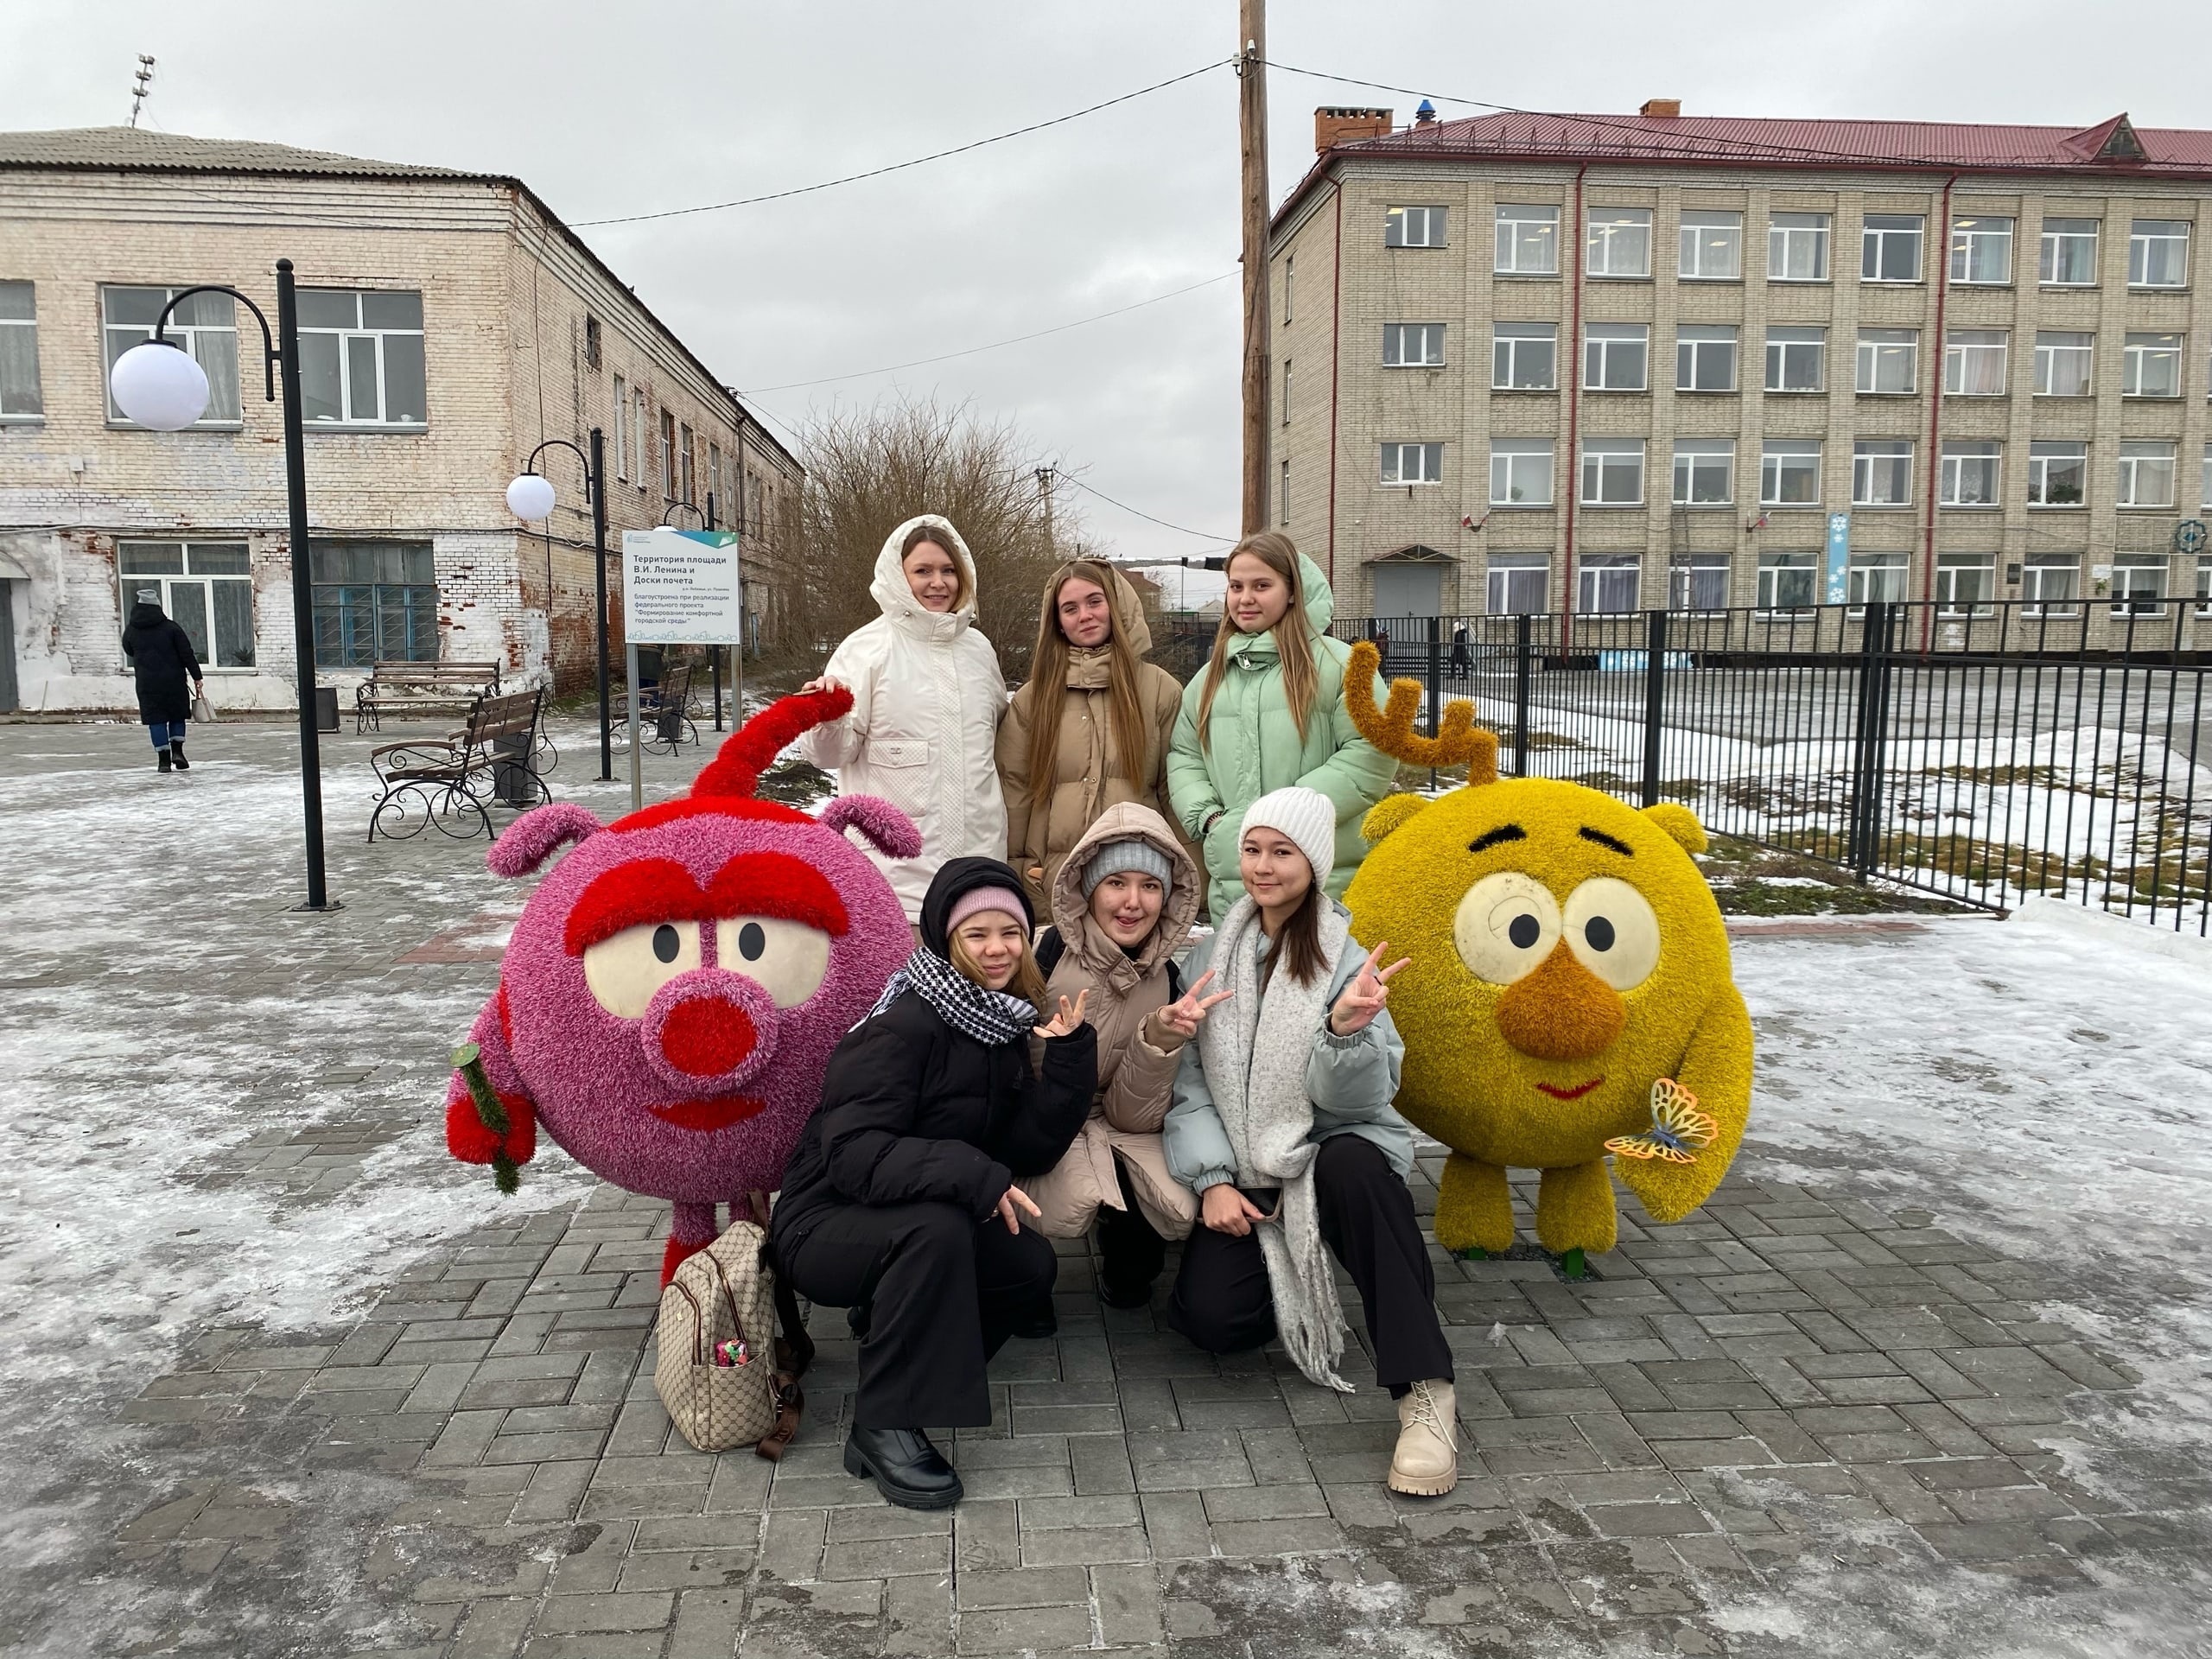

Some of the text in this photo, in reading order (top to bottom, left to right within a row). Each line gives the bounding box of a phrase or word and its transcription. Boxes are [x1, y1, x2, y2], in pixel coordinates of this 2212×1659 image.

[633, 555, 727, 565] Территория площади
[633, 565, 652, 574] В.И.
[654, 565, 687, 574] Ленина
[633, 575, 661, 585] Доски
[634, 593, 678, 601] благоустроена
